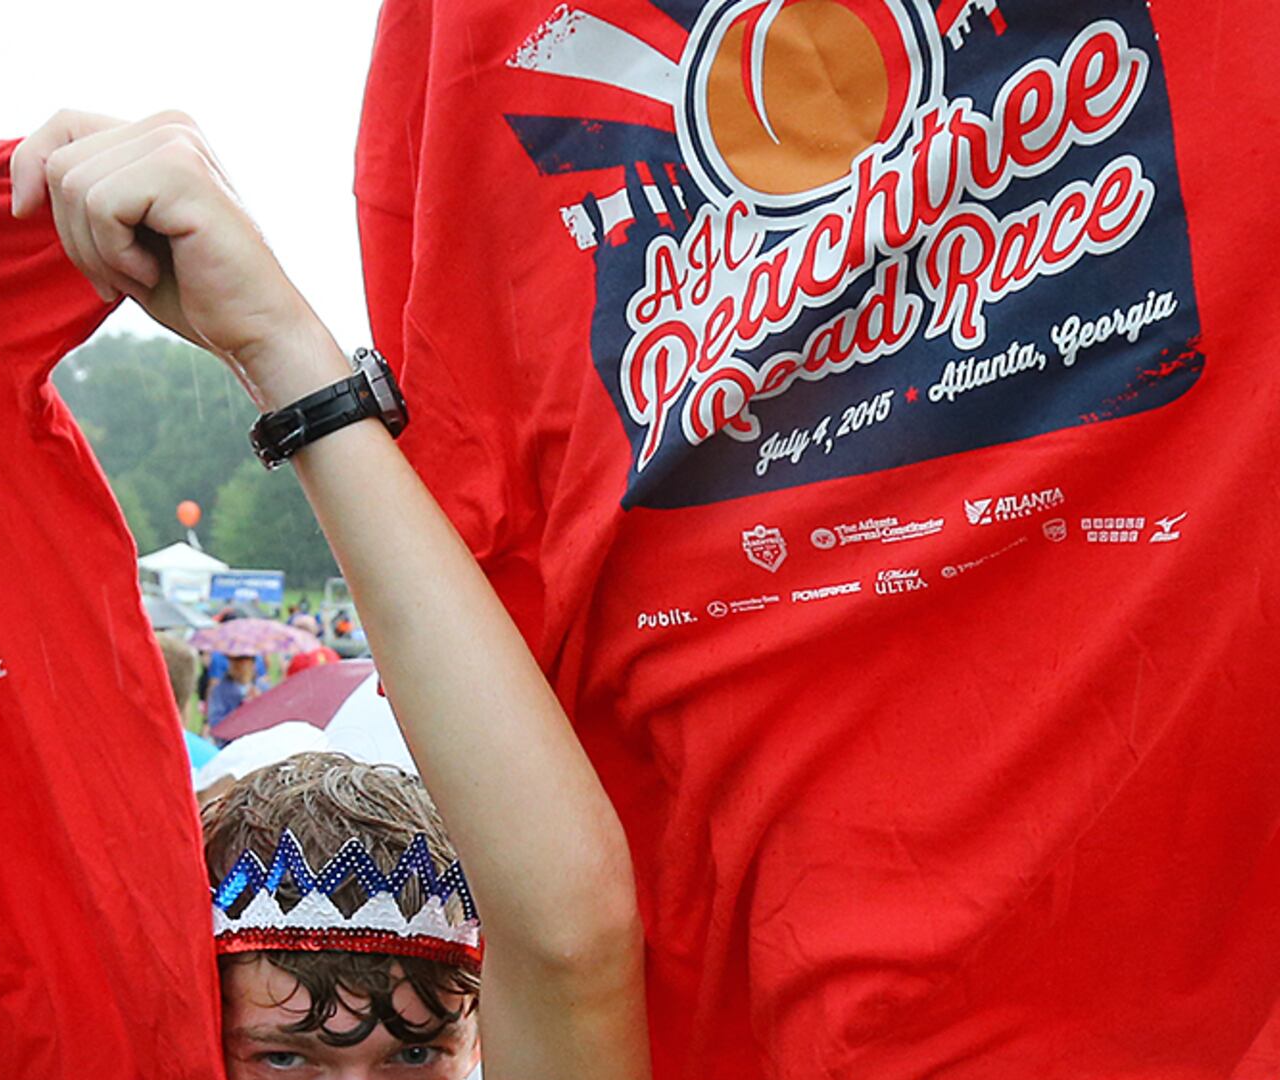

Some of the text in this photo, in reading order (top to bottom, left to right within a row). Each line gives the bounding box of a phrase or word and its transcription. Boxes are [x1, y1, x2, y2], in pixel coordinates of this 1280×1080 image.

[624, 26, 1145, 467] Peachtree
[634, 198, 759, 325] AJC
[924, 164, 1146, 341] Race
[755, 428, 811, 476] July
[836, 389, 895, 437] 2015
[928, 340, 1048, 402] Atlanta,
[1051, 289, 1178, 366] Georgia
[995, 487, 1065, 514] ATLANTA
[874, 577, 928, 596] ULTRA
